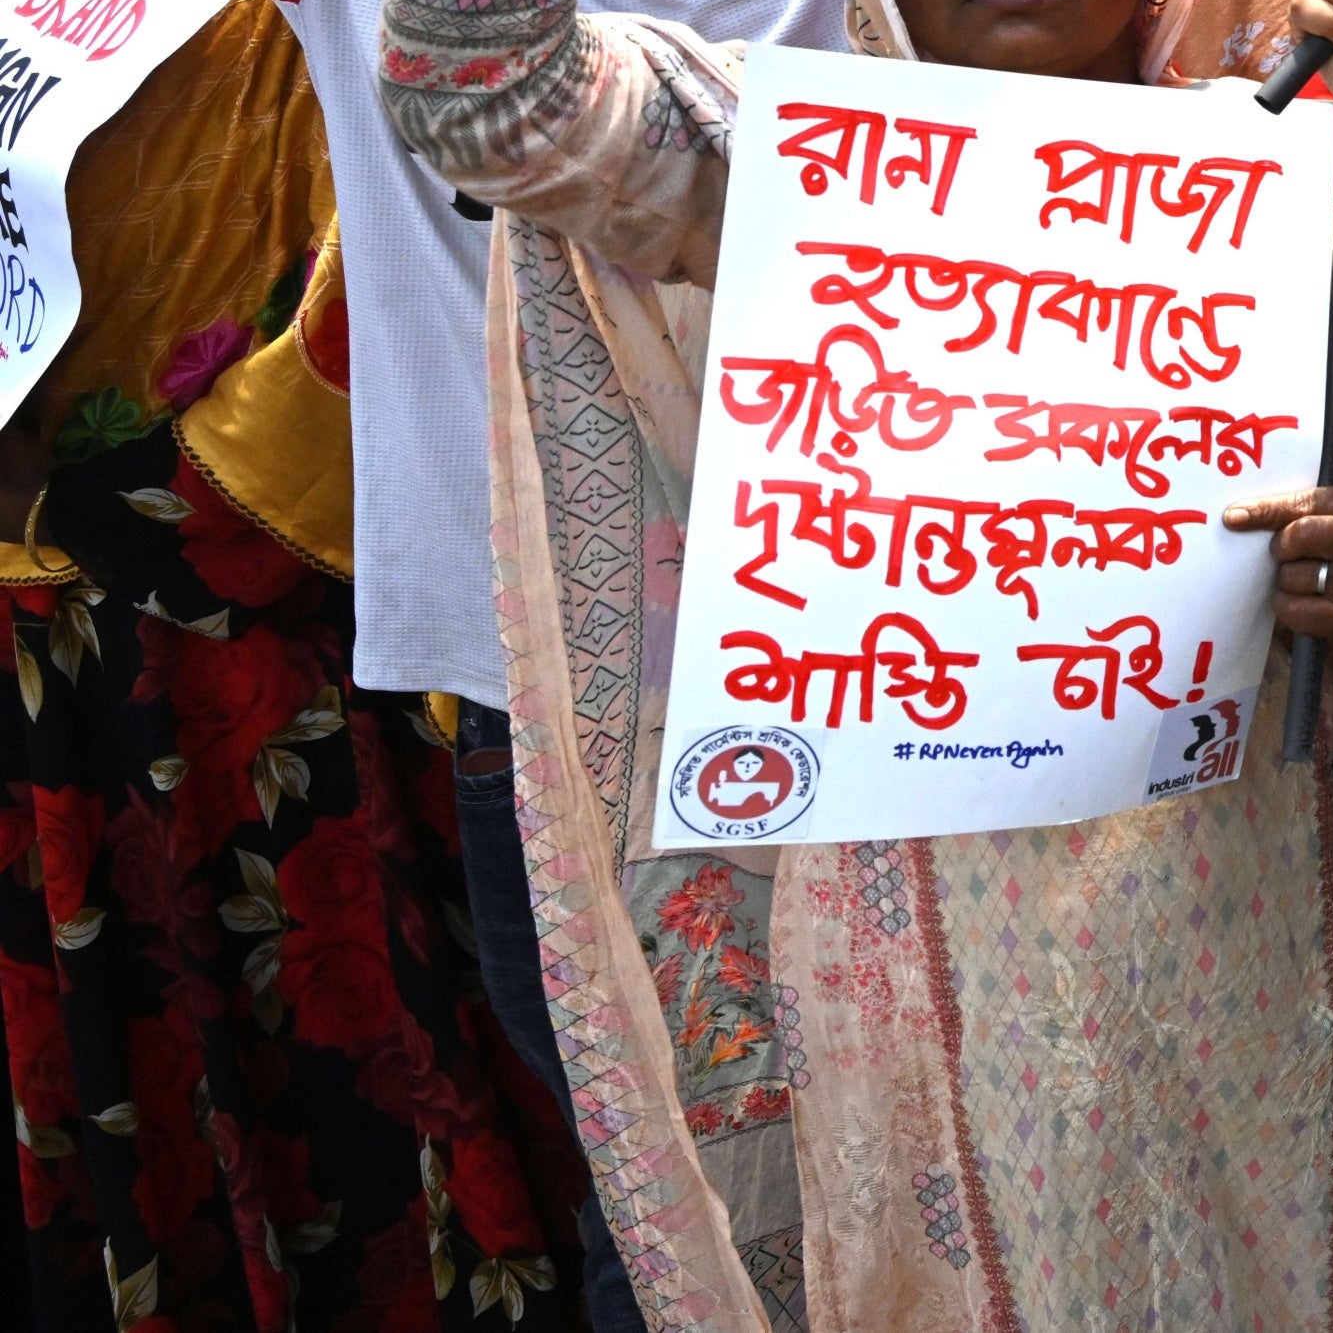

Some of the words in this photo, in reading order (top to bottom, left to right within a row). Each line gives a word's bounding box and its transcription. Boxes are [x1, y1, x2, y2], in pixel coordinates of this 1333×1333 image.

[1035, 137, 1282, 254] প্লাজা
[984, 393, 1299, 498] সকলের
[712, 819, 768, 836] SGSF
